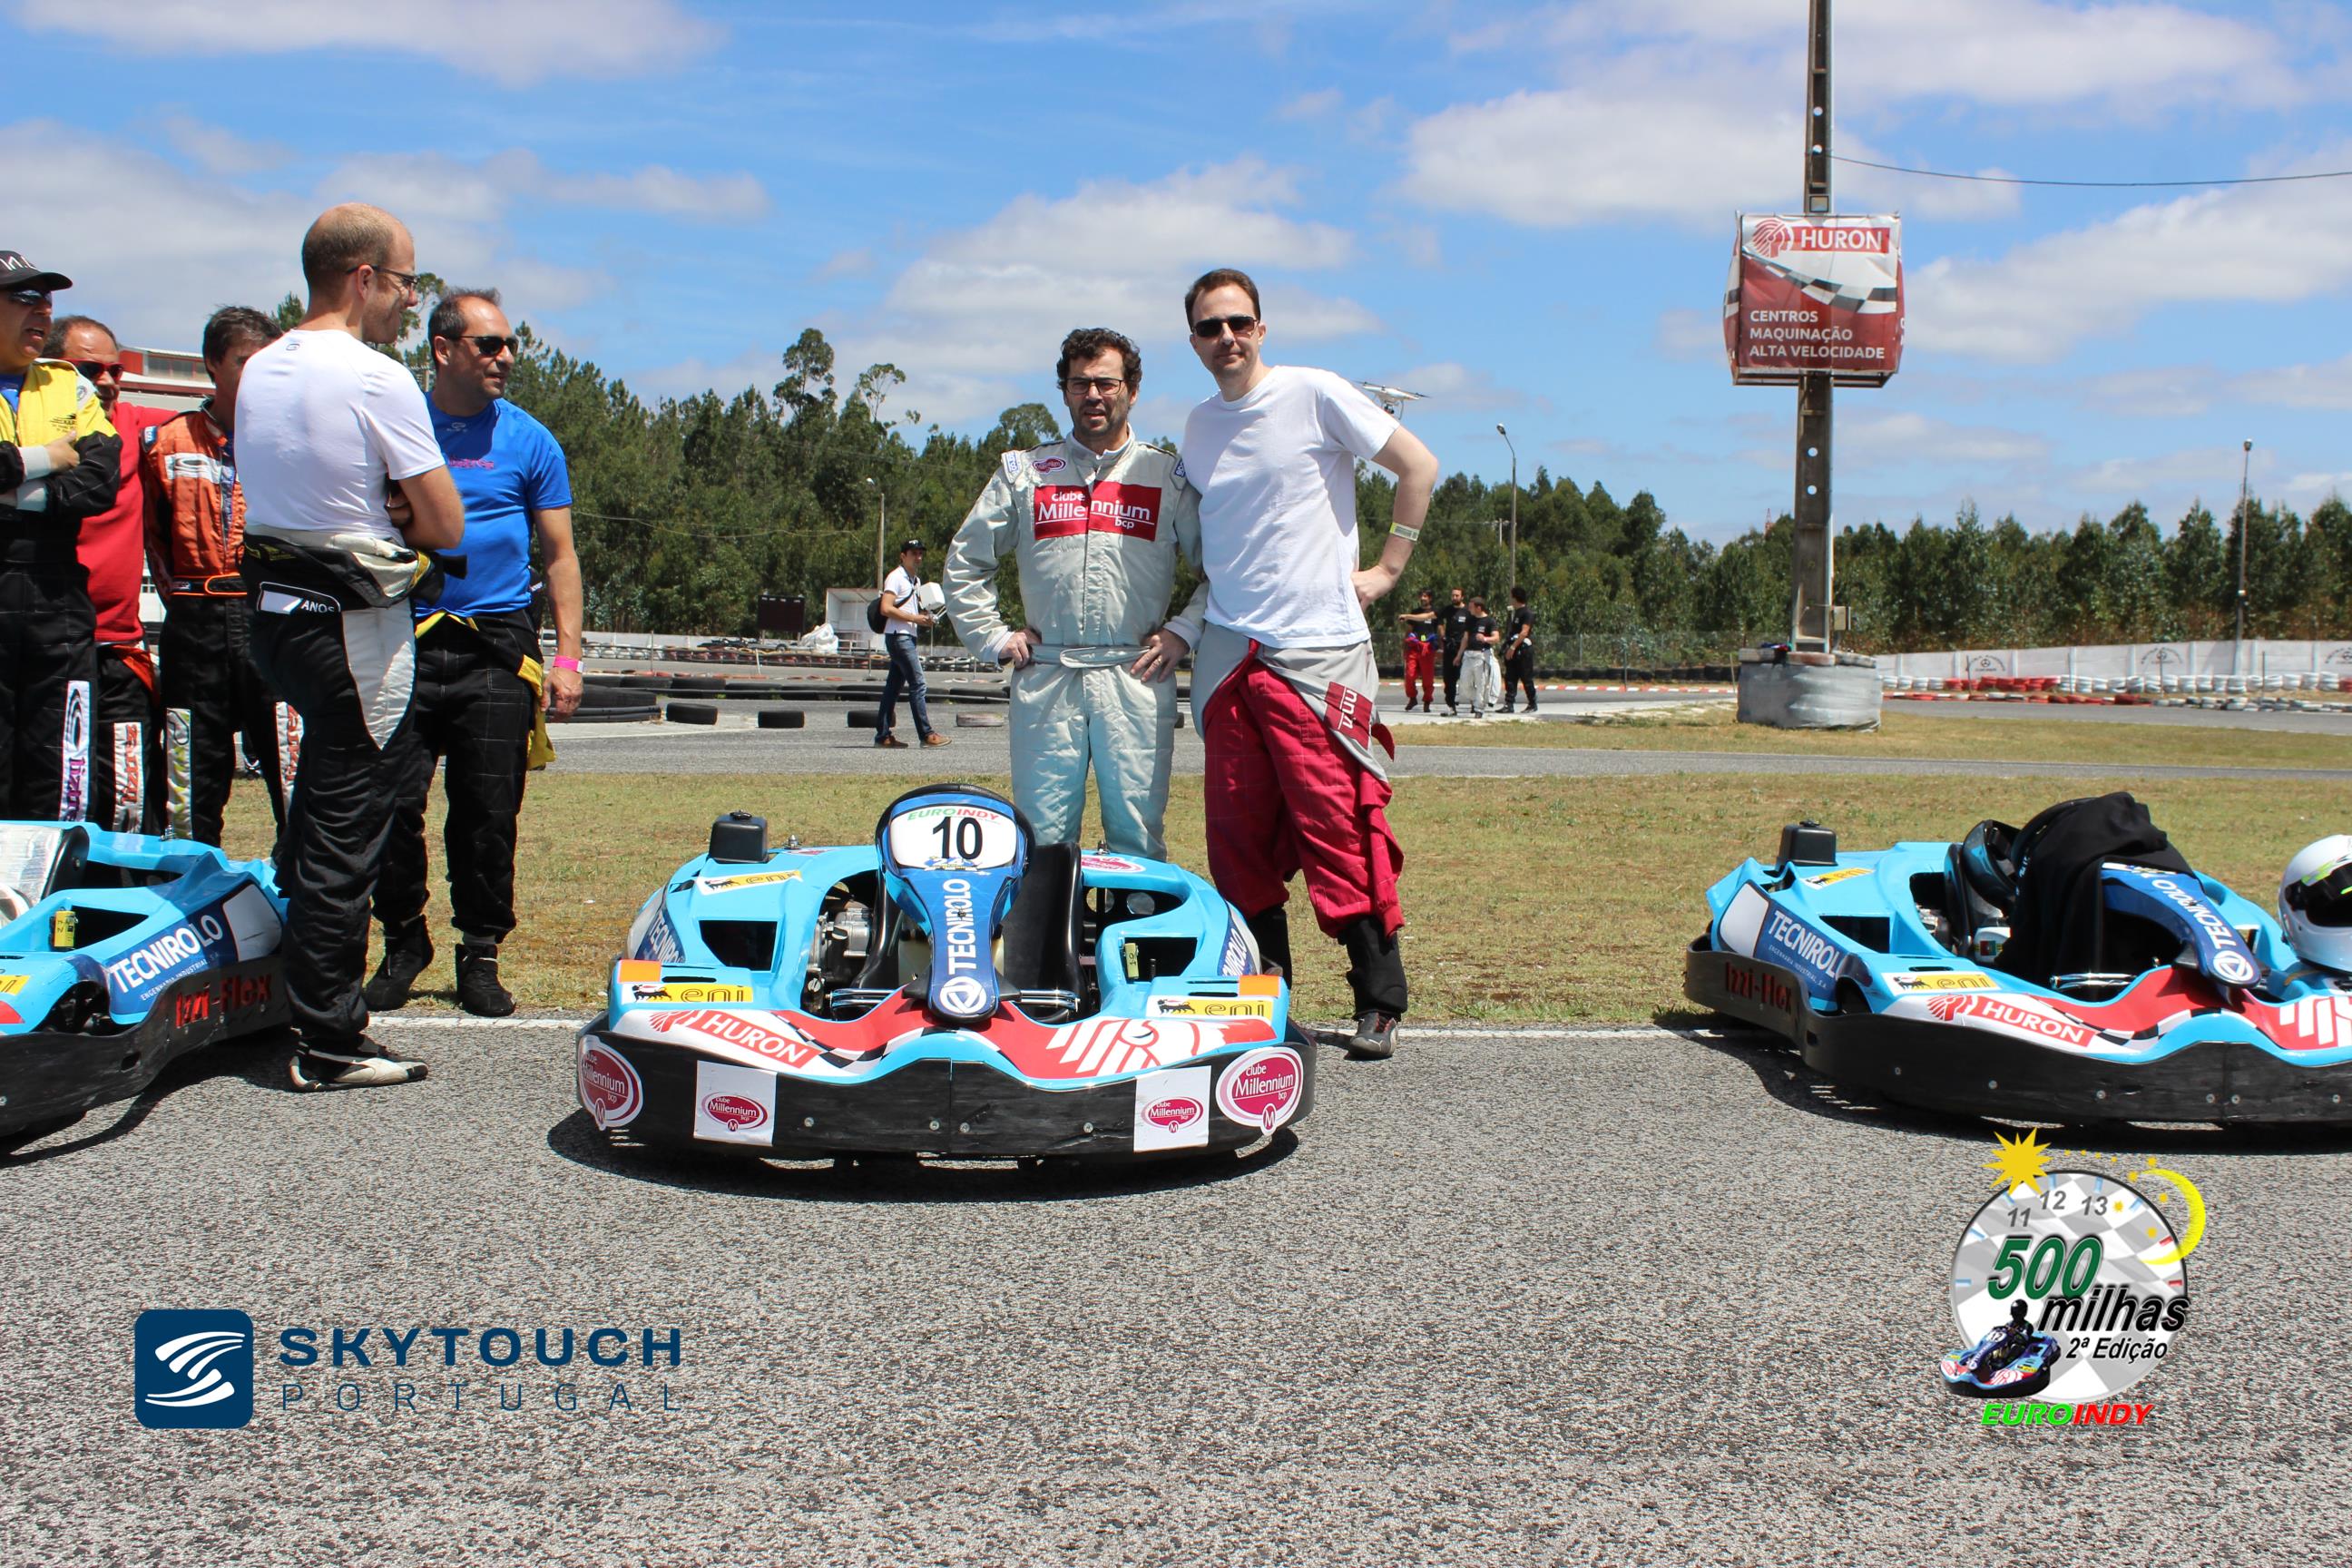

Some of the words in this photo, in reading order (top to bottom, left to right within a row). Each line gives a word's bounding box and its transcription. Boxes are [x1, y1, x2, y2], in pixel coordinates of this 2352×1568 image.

[1801, 229, 1882, 250] HURON
[1749, 309, 1818, 323] CENTROS
[1749, 326, 1853, 342] MAQUINAÇÃO
[1749, 346, 1787, 358] ALTA
[1790, 347, 1886, 359] VELOCIDADE
[1051, 491, 1085, 502] clube
[1038, 500, 1151, 521] Millennium
[1114, 516, 1134, 530] bcp
[906, 808, 1000, 821] EUROINDY
[933, 816, 984, 860] 10
[943, 878, 977, 975] TECNIROLO
[1769, 910, 1839, 979] TECNIROL
[109, 915, 223, 993] TECNIROLO
[1936, 974, 1991, 989] eni
[681, 985, 744, 1003] eni
[1204, 1000, 1264, 1016] eni
[1983, 1000, 2084, 1043] HURON
[701, 1014, 808, 1063] HURON
[582, 1061, 625, 1094] Millennium
[1246, 1063, 1267, 1076] clube
[1235, 1073, 1294, 1097] Millennium
[1278, 1091, 1288, 1101] bcp
[710, 1101, 757, 1116] Millennium
[1150, 1106, 1195, 1117] Millennium
